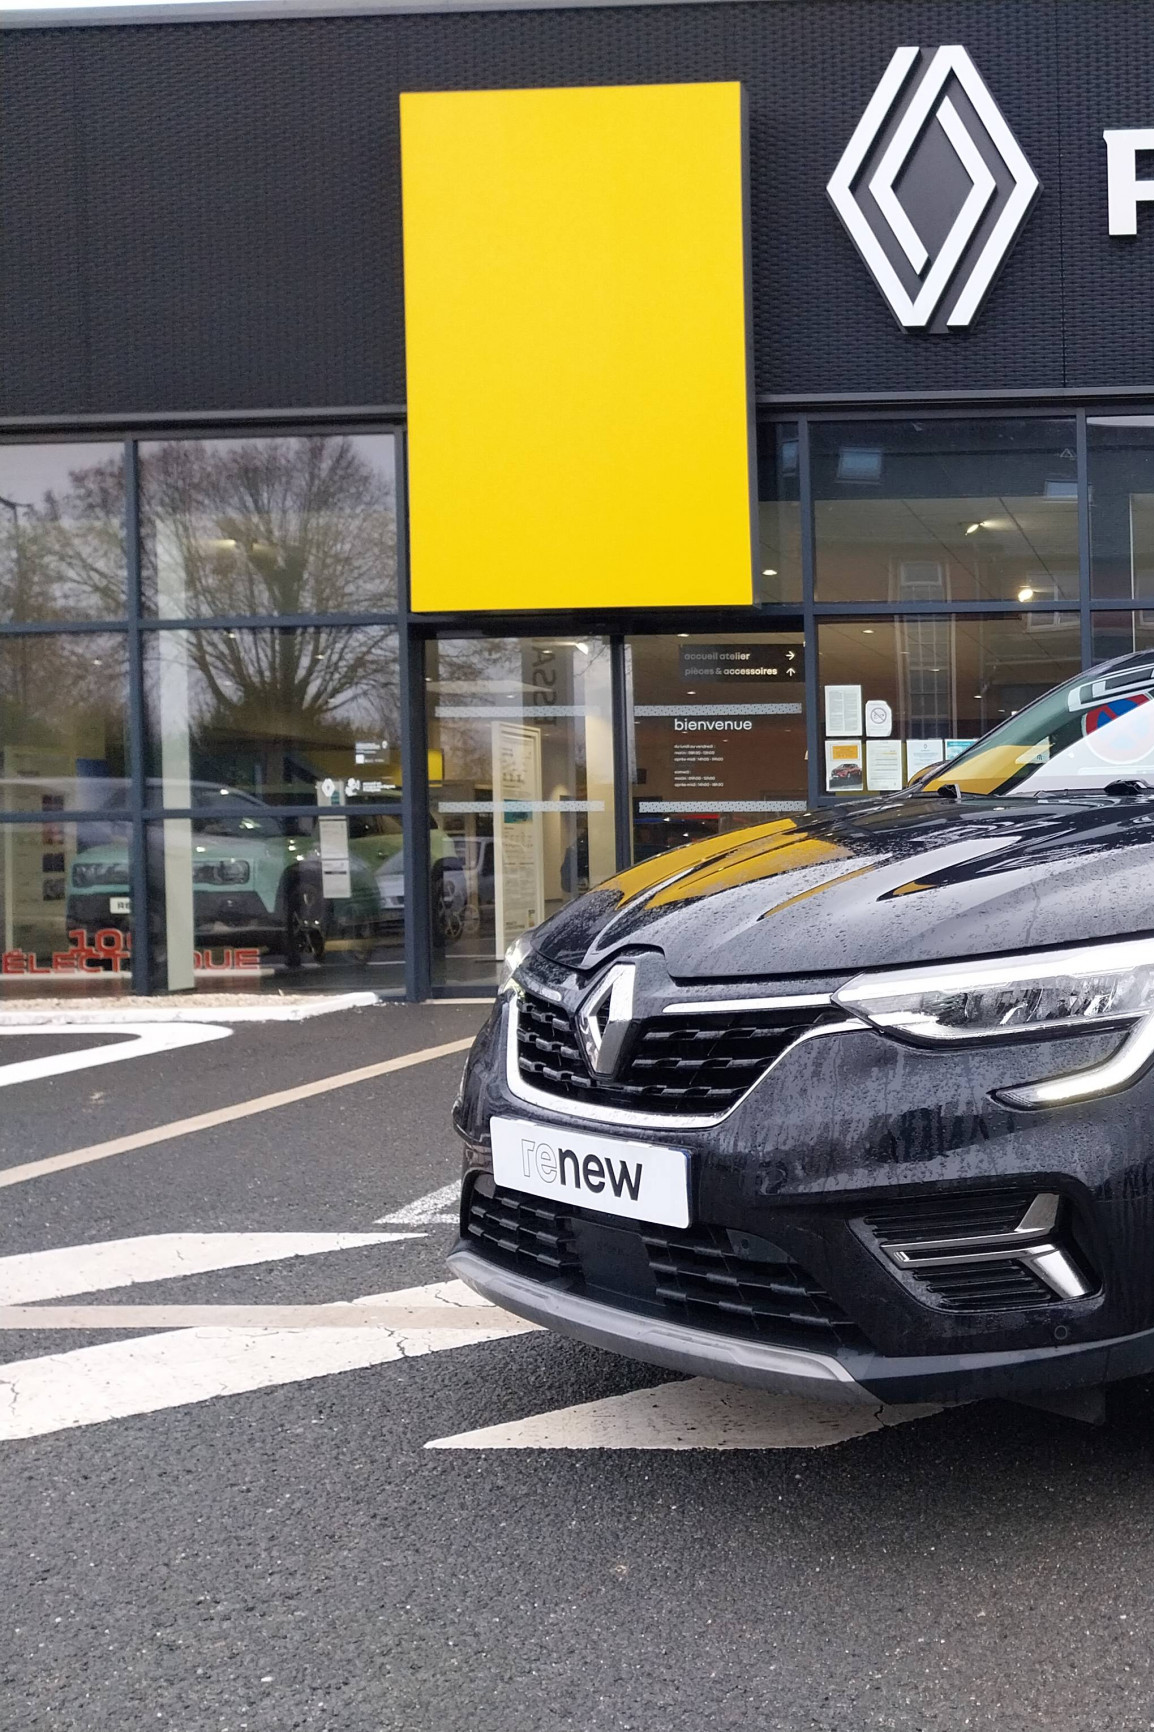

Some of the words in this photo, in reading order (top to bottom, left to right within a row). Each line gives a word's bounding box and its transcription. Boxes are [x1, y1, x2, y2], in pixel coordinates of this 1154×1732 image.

[684, 651, 718, 661] accueil
[719, 652, 751, 661] atelier
[684, 666, 715, 676] pièces
[715, 667, 722, 675] &
[723, 666, 778, 676] accessoires
[674, 718, 753, 731] bienvenue
[521, 1138, 643, 1202] renew
